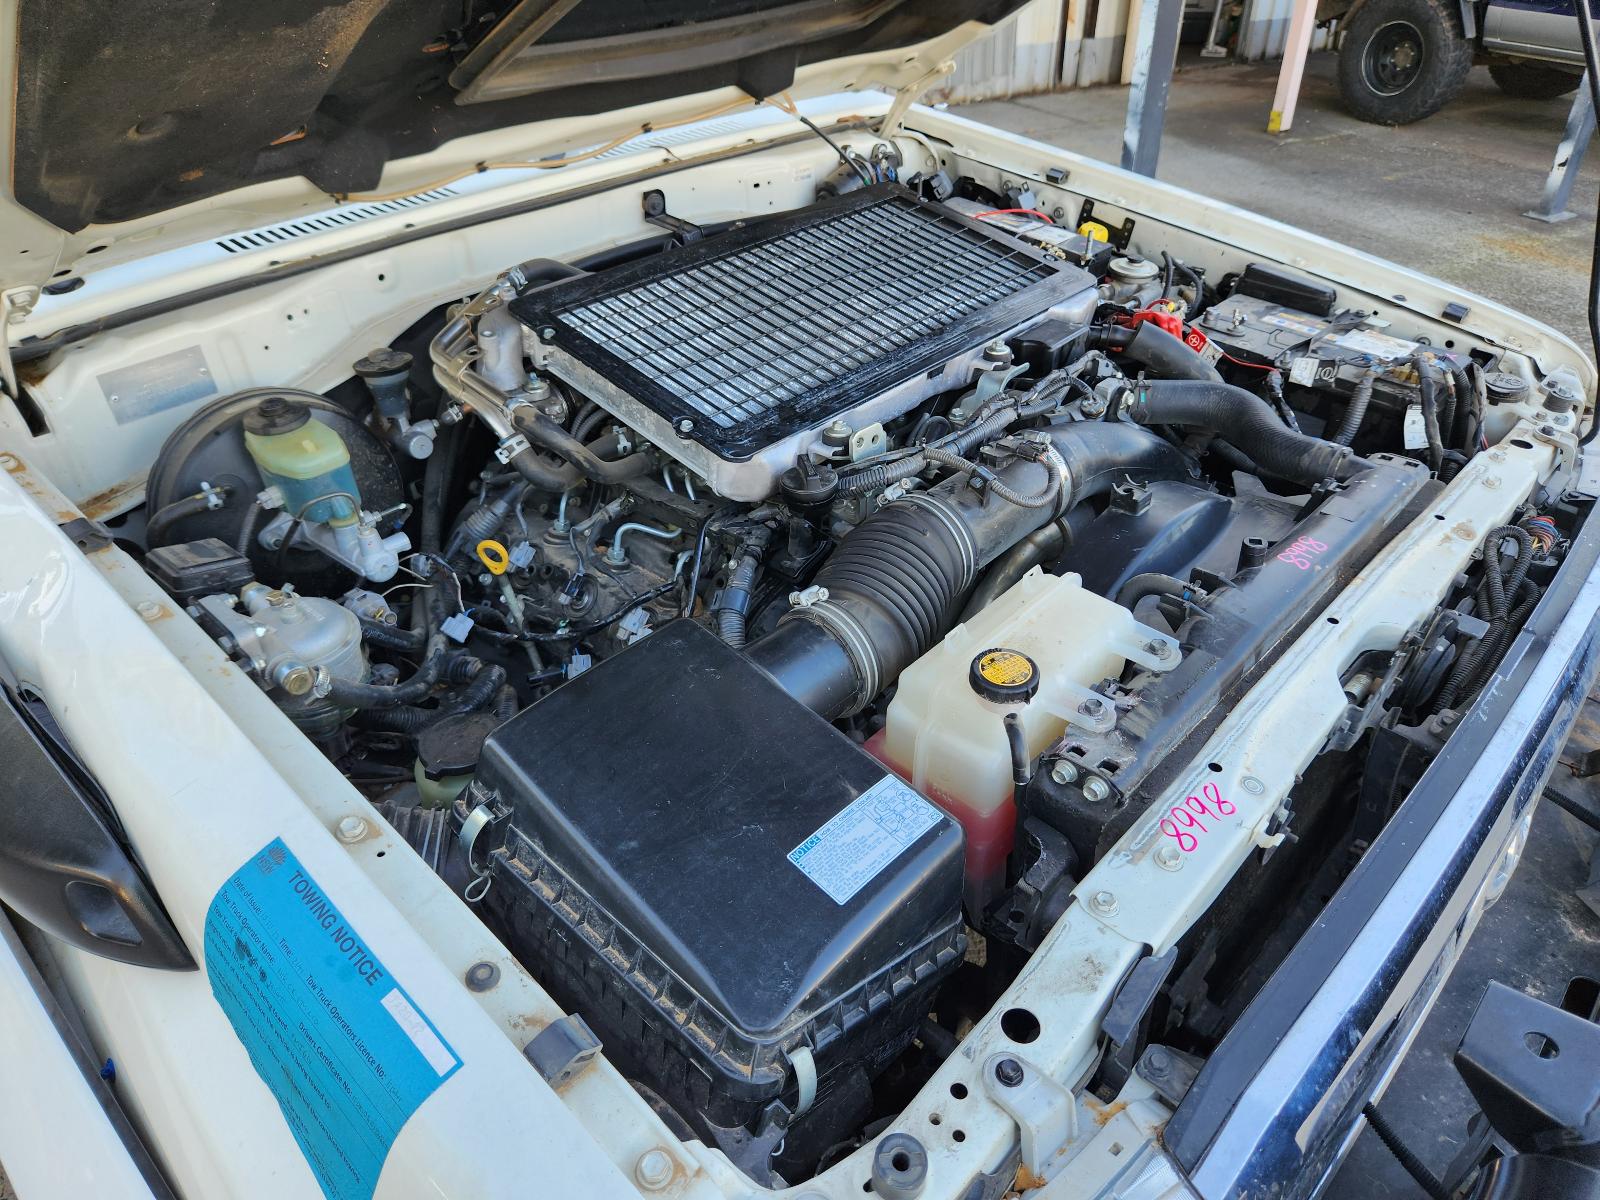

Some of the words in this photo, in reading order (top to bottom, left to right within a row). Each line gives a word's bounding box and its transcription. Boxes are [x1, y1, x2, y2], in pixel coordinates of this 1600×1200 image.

[1276, 535, 1329, 571] 8998
[790, 835, 821, 862] NOTICE
[1159, 782, 1237, 852] 8998
[221, 889, 232, 905] Tow
[229, 902, 244, 921] Truck
[241, 917, 262, 945] Operator
[259, 943, 275, 966] Name:
[288, 870, 337, 931] TOWING
[331, 926, 383, 987] NOTICE
[233, 877, 246, 893] Date
[247, 896, 262, 914] Issue:
[279, 938, 294, 959] Time:
[306, 974, 319, 991] Tow
[316, 986, 332, 1009] Truck
[330, 1006, 358, 1041] Operators
[354, 1038, 376, 1067] Licence
[374, 1064, 386, 1080] No:
[316, 1046, 343, 1084] Certificate
[342, 1081, 353, 1097] No:
